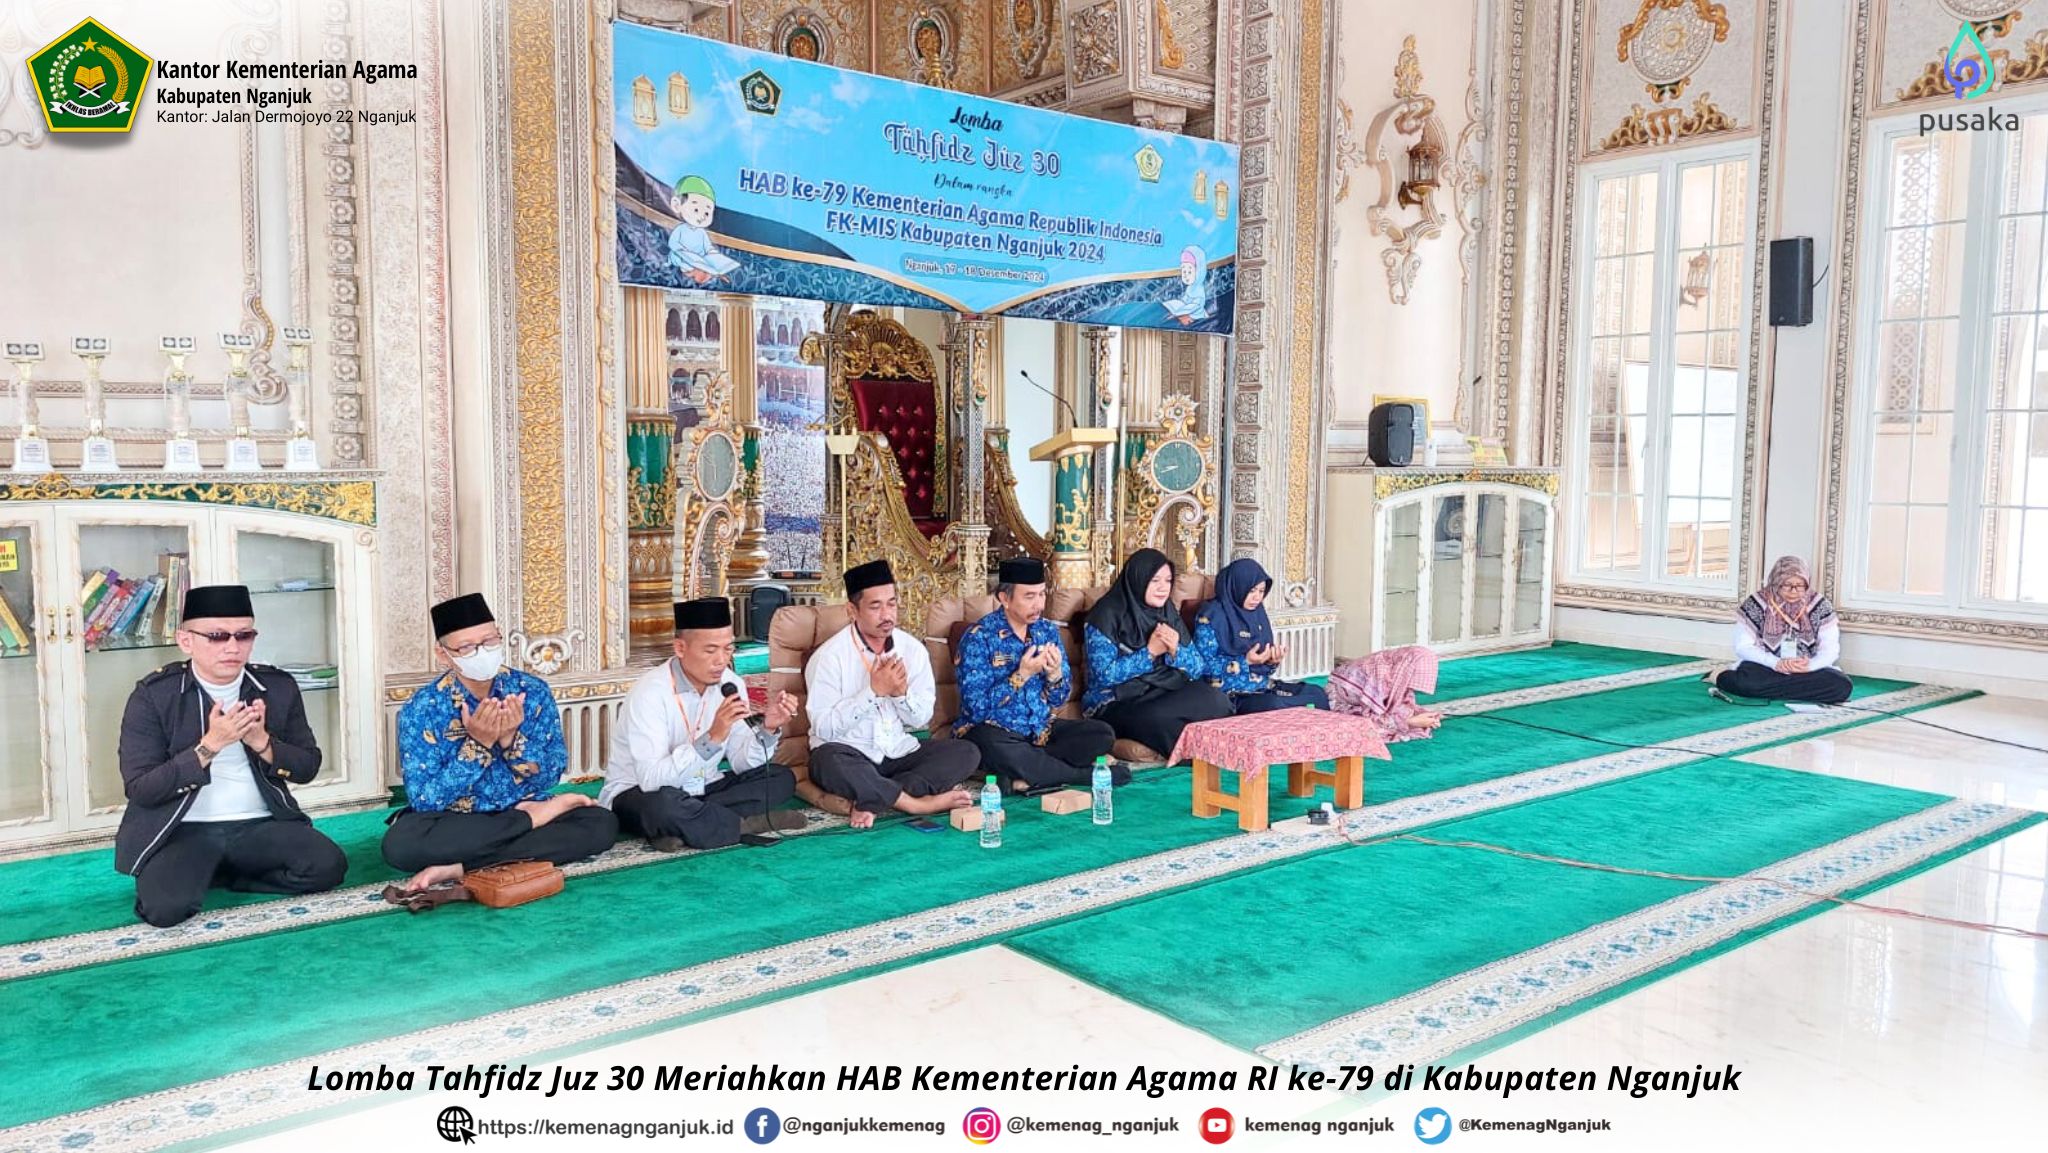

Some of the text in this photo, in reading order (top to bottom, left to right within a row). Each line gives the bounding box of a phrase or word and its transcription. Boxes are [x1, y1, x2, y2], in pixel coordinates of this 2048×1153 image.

[949, 106, 1003, 133] Lomba
[1033, 150, 1061, 178] 30
[934, 173, 1012, 199] Dalam rangka
[739, 168, 1164, 247] HAB ke-79 Kementerian Agama Republik Indonesia
[825, 210, 1106, 263] FK-MIS Kabupaten Nganjuk 2024
[978, 266, 1023, 280] Desember
[1023, 270, 1045, 283] 2024
